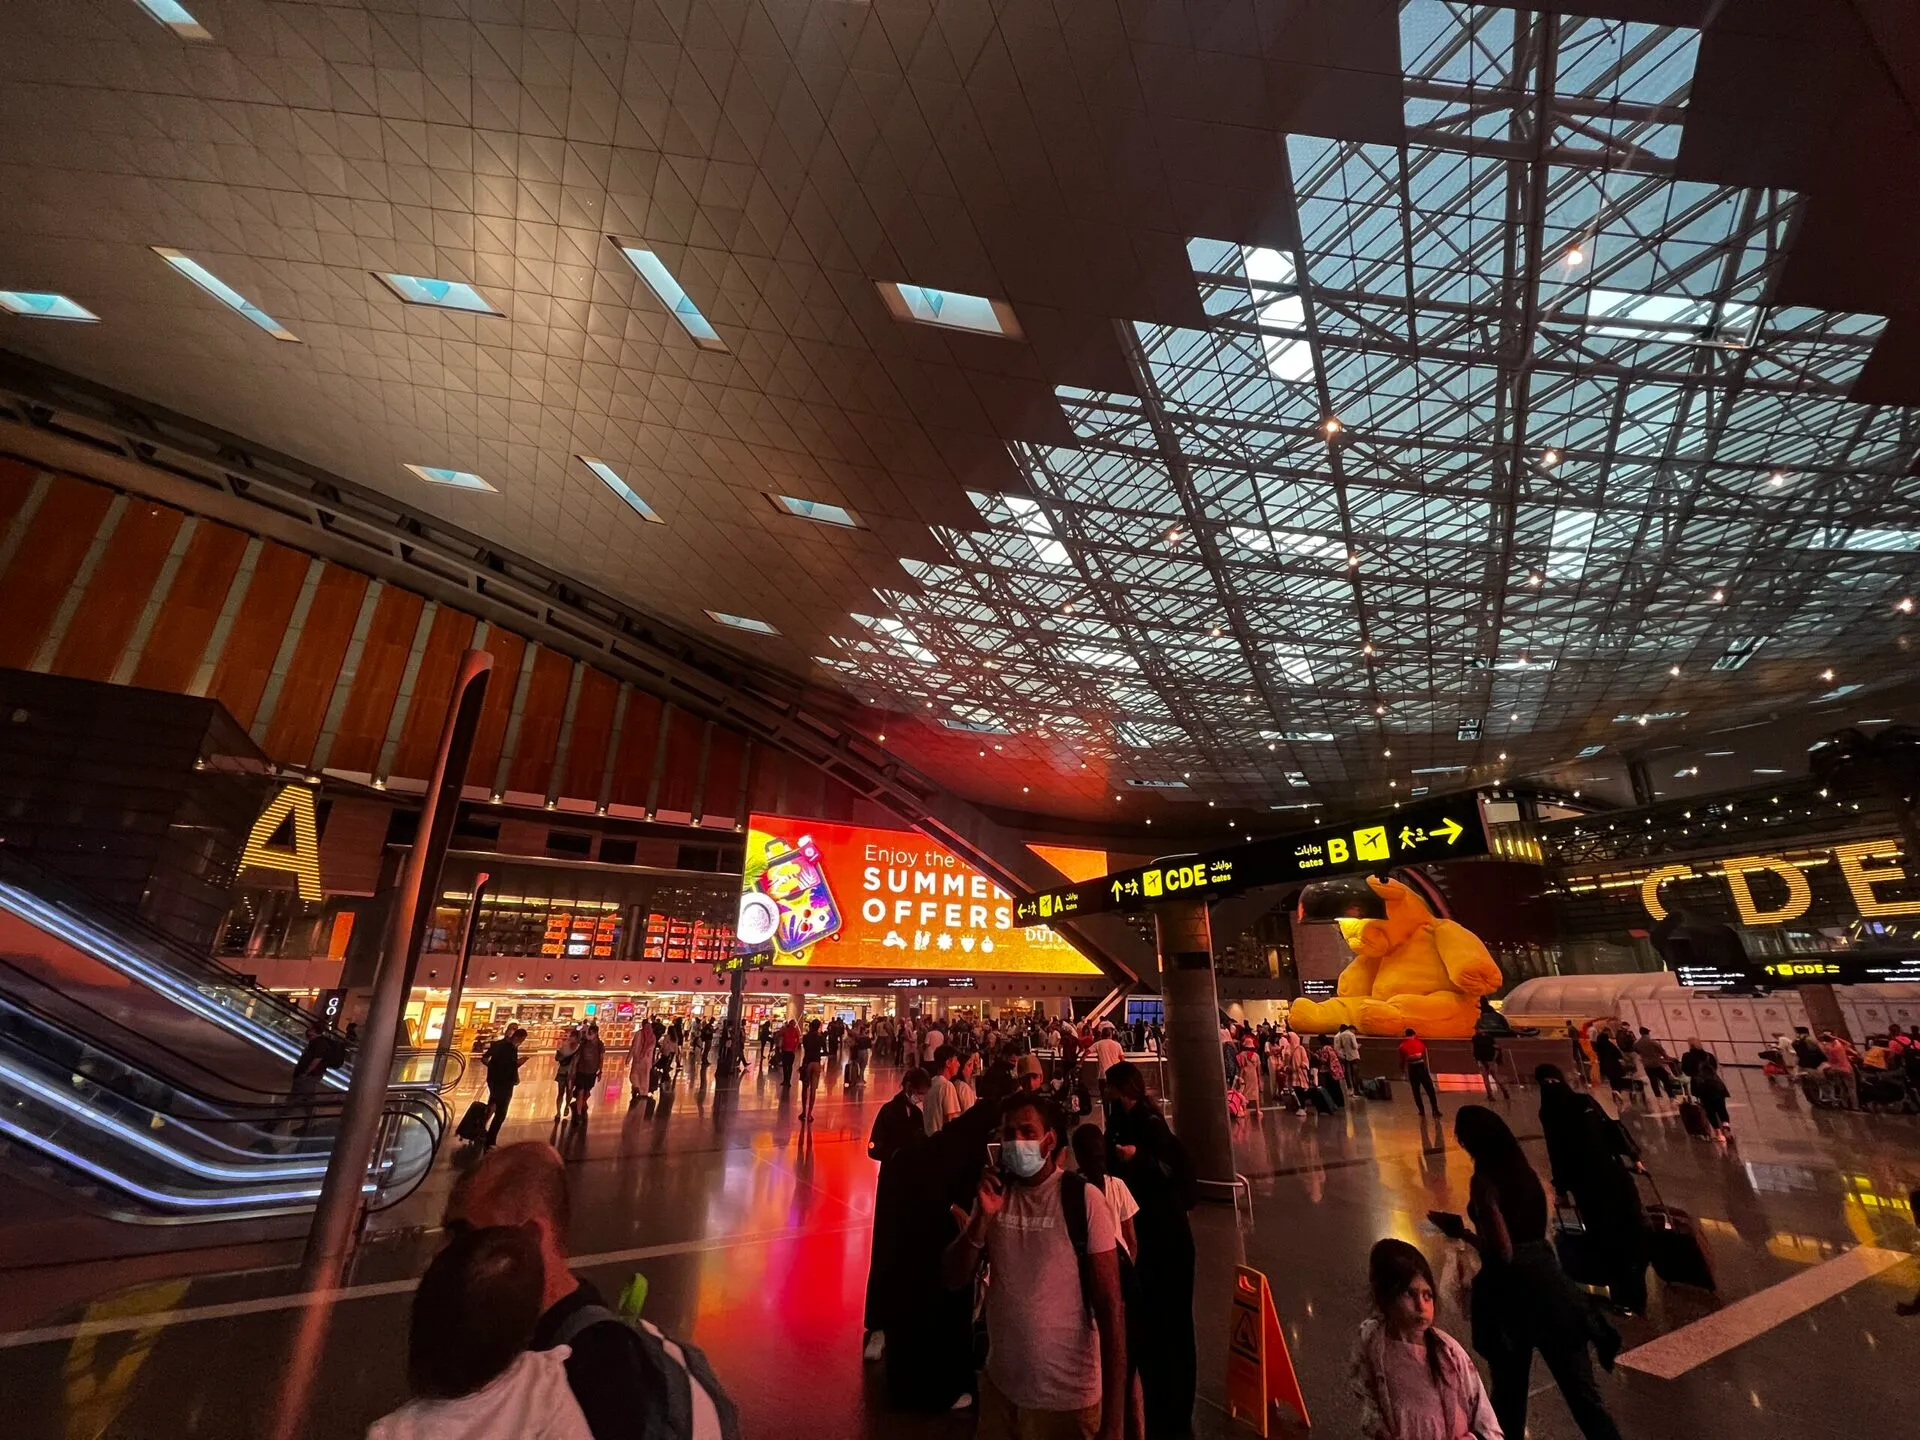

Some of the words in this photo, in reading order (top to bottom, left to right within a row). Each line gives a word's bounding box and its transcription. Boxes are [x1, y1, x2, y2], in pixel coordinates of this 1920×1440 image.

[235, 785, 322, 901] A
[1294, 843, 1322, 857] بوابات
[1327, 838, 1350, 864] B
[865, 844, 918, 867] Enjoy
[925, 850, 955, 867] the
[1299, 858, 1323, 869] Gates
[1210, 860, 1232, 872] بوابات
[1165, 863, 1208, 891] CDE
[1211, 873, 1231, 884] Gates
[1054, 895, 1063, 913] A
[862, 898, 1011, 930] OFFERS
[1793, 964, 1825, 975] CDE
